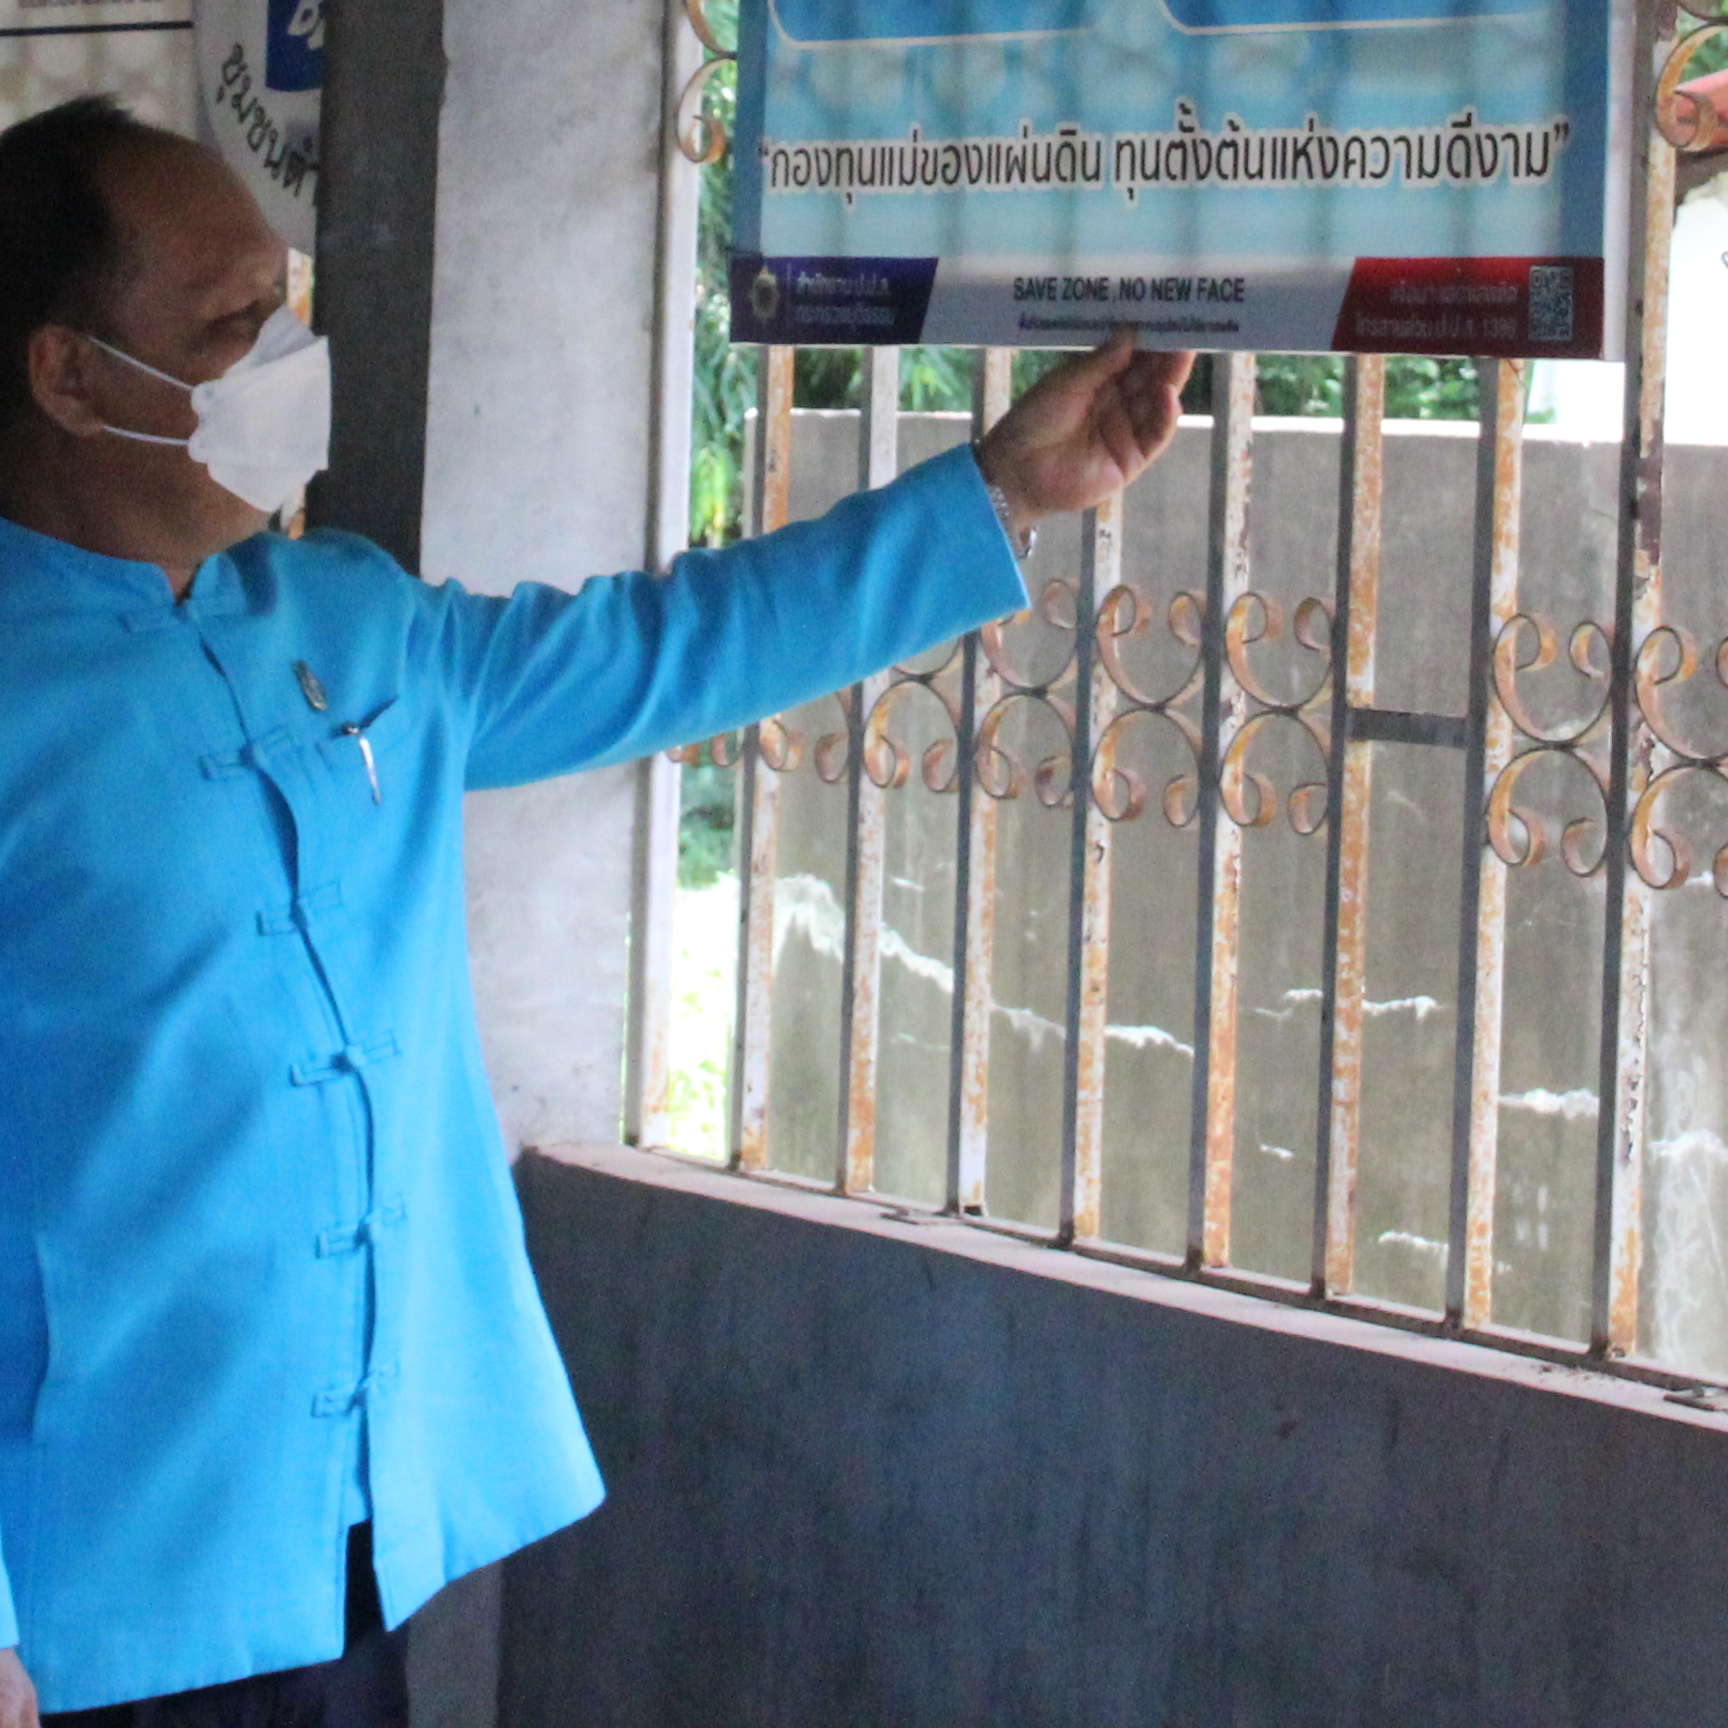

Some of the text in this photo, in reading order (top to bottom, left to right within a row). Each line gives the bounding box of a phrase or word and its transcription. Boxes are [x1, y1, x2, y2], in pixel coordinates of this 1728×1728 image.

[759, 97, 1570, 208] “กองทุนแม่ของแผ่นดิน ทุนตั้งต้นแห่งความดีงาม”
[1014, 276, 1057, 301] SAVE
[1120, 276, 1146, 301] NO
[1151, 276, 1192, 302] NEW
[1197, 277, 1245, 303] FACE
